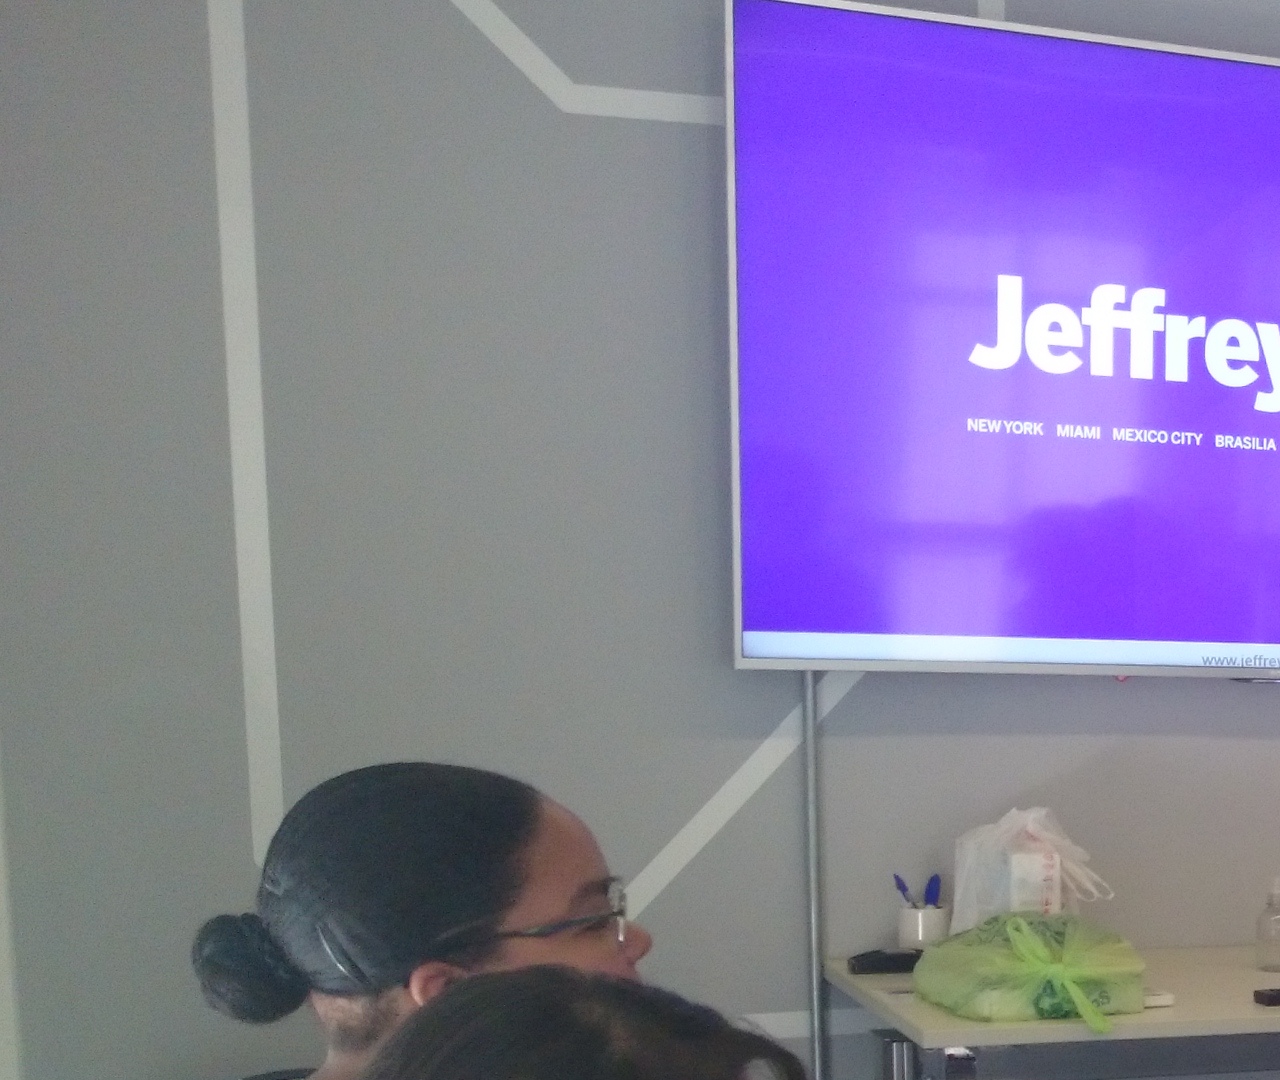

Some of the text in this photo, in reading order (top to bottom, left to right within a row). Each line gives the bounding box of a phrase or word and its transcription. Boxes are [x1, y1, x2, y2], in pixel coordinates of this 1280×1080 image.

[967, 417, 1000, 432] NEW
[1002, 420, 1043, 435] YORK
[1056, 423, 1100, 439] MIAMI
[1112, 427, 1168, 443] MEXICO
[1170, 430, 1202, 446] CITY
[1215, 434, 1276, 451] BRASILIA
